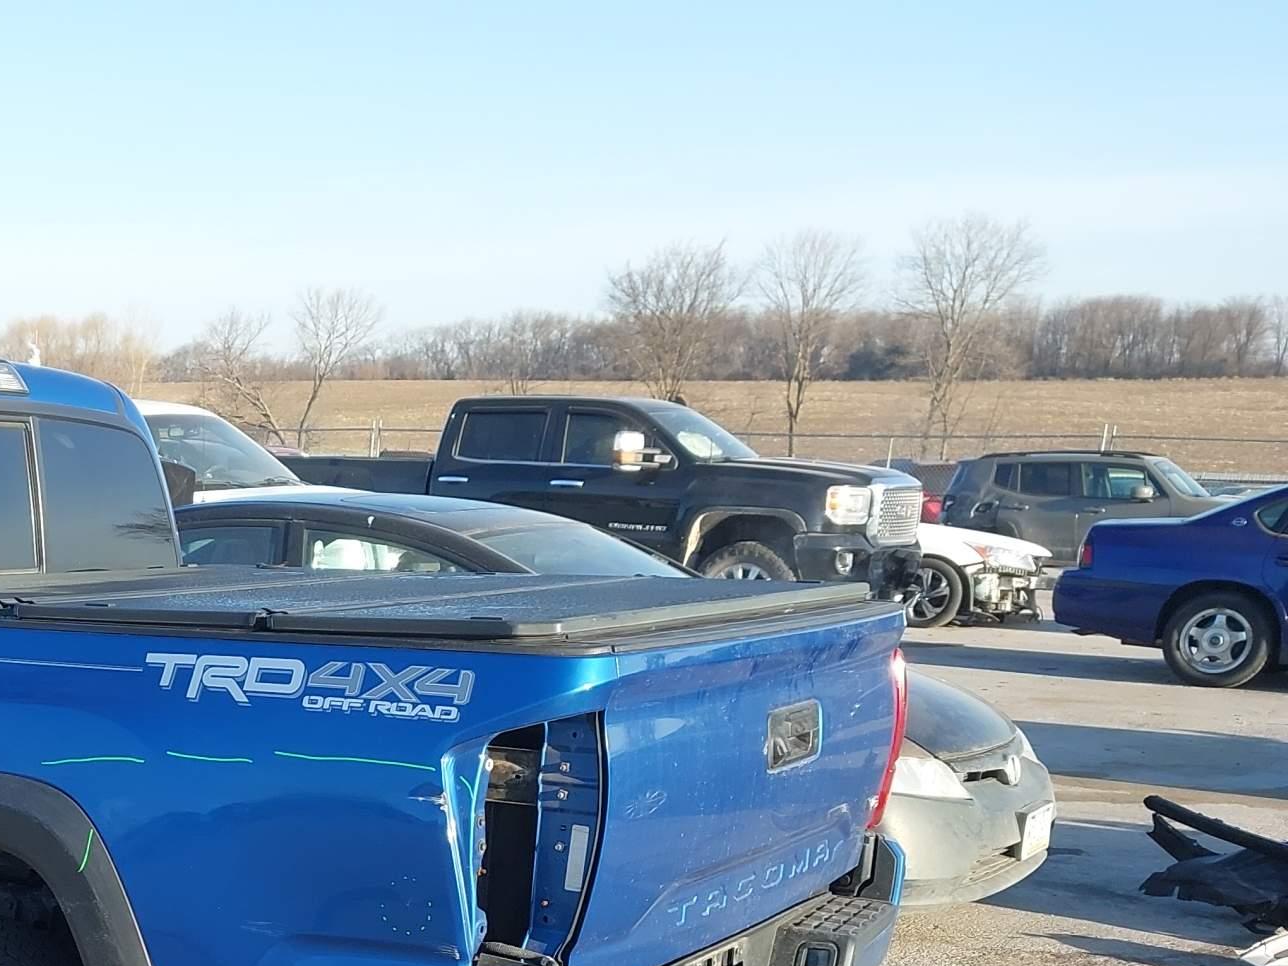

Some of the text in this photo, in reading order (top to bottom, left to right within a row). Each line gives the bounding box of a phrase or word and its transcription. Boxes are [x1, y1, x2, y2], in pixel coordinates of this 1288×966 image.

[145, 652, 476, 706] TRD 4X4
[302, 695, 460, 722] OFF ROAD
[667, 838, 845, 926] TACOMA
